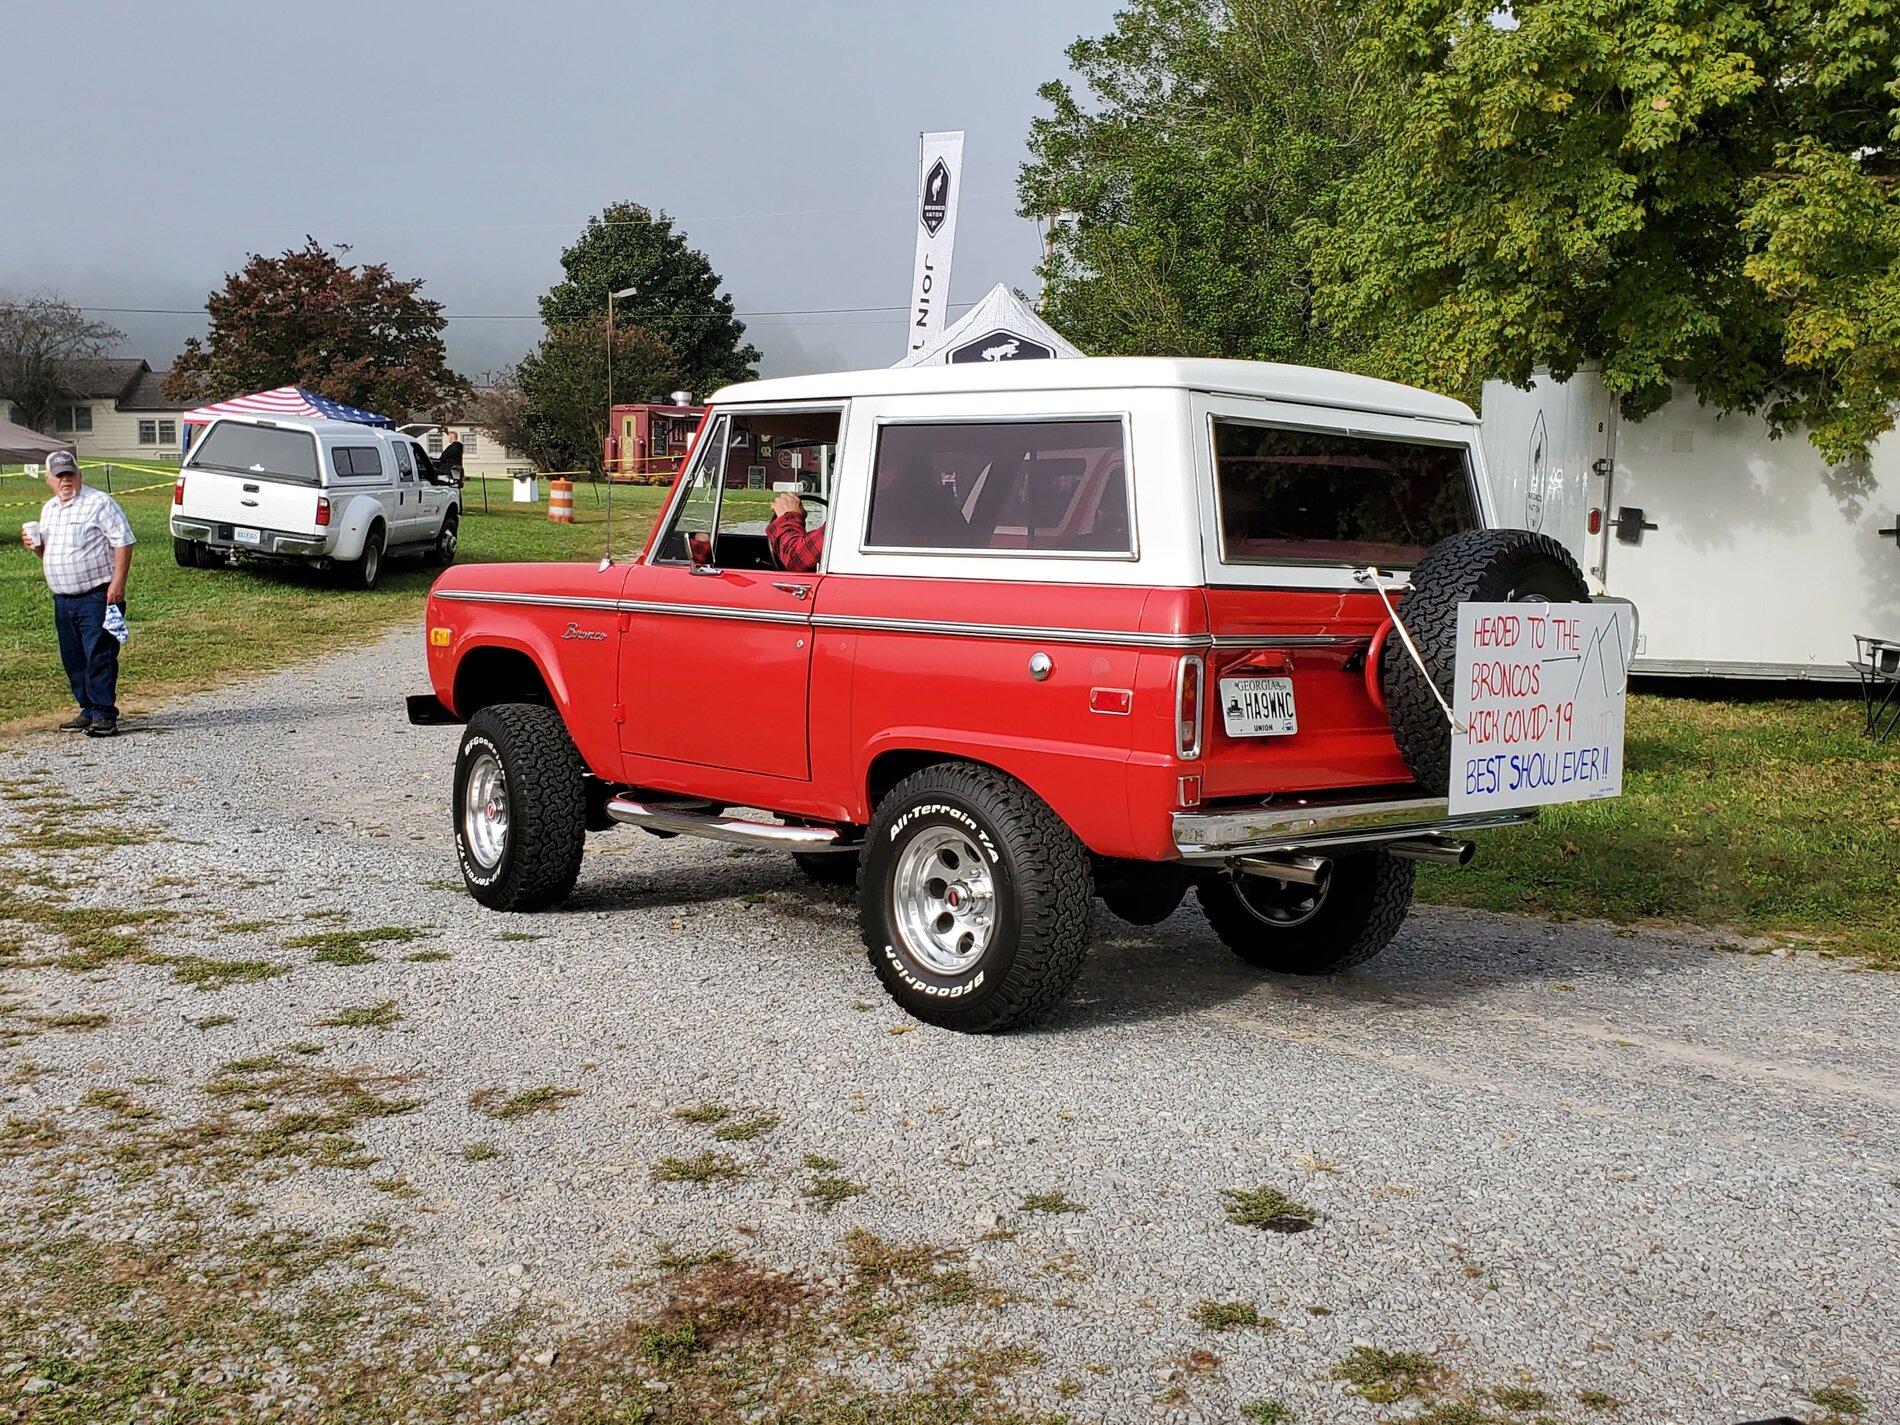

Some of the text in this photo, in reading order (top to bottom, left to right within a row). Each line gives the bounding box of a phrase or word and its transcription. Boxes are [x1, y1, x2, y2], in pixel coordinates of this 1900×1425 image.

[915, 254, 934, 327] JOIN
[561, 622, 607, 640] Bronco
[1473, 615, 1580, 651] HEADED TO THE
[1470, 661, 1540, 700] BRONCOS
[1253, 724, 1274, 732] UNION
[1467, 701, 1573, 745] KICK COVID-19
[1466, 755, 1506, 795] BEST
[1509, 752, 1558, 791] SHOW
[890, 804, 999, 864] All-Terrain T/A
[885, 945, 985, 998] BFGoodrich
